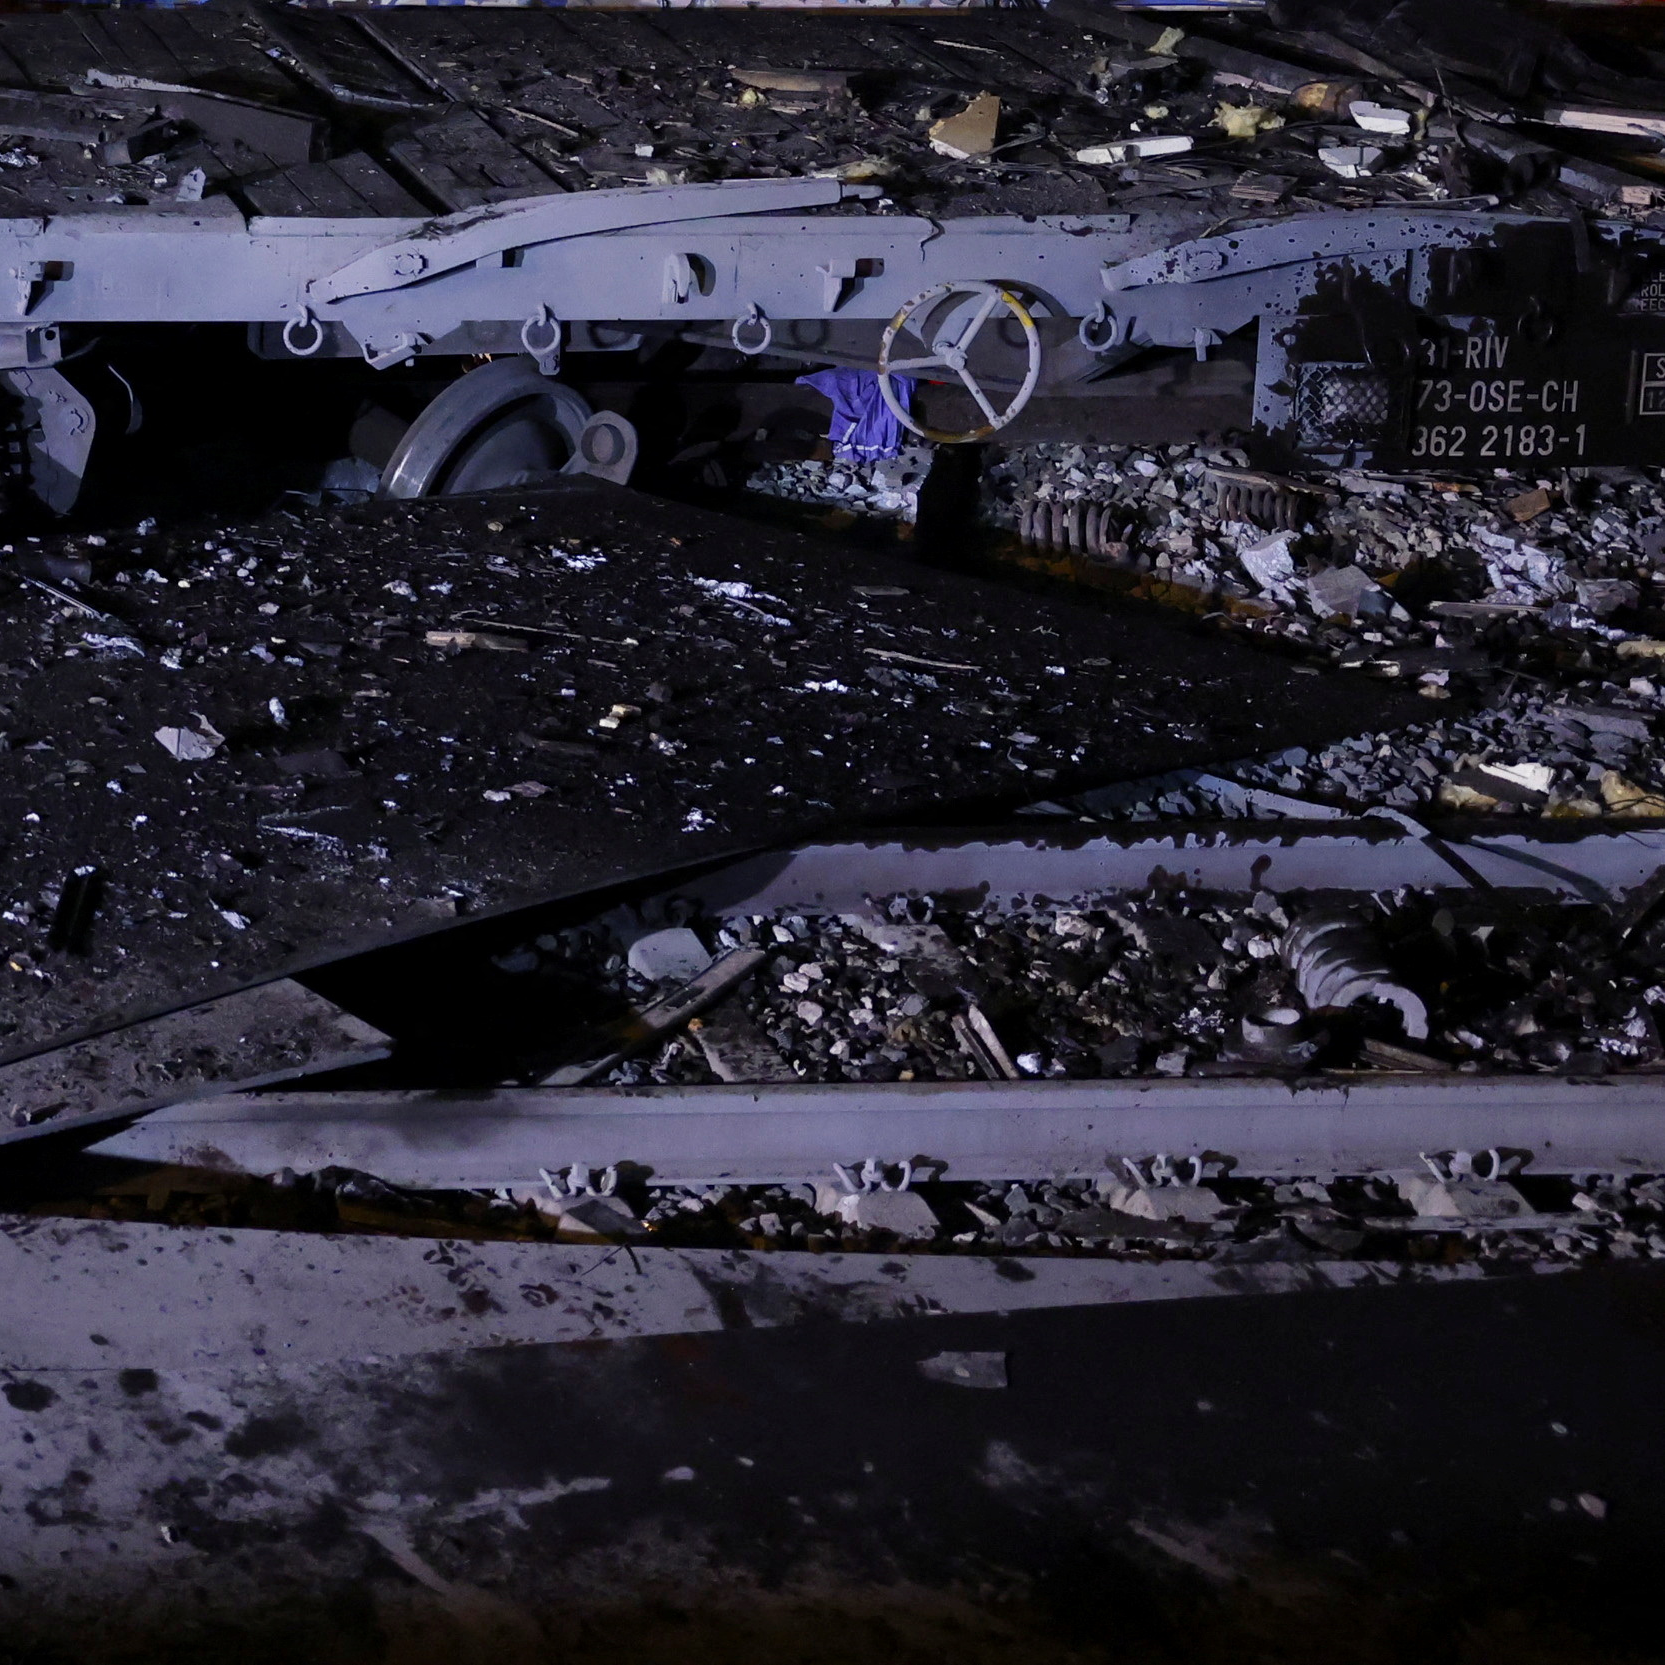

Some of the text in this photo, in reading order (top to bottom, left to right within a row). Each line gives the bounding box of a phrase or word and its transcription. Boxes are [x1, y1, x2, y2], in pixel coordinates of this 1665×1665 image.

[1416, 379, 1579, 413] 73-OSE-CH
[1411, 423, 1587, 457] 362 2183-1
